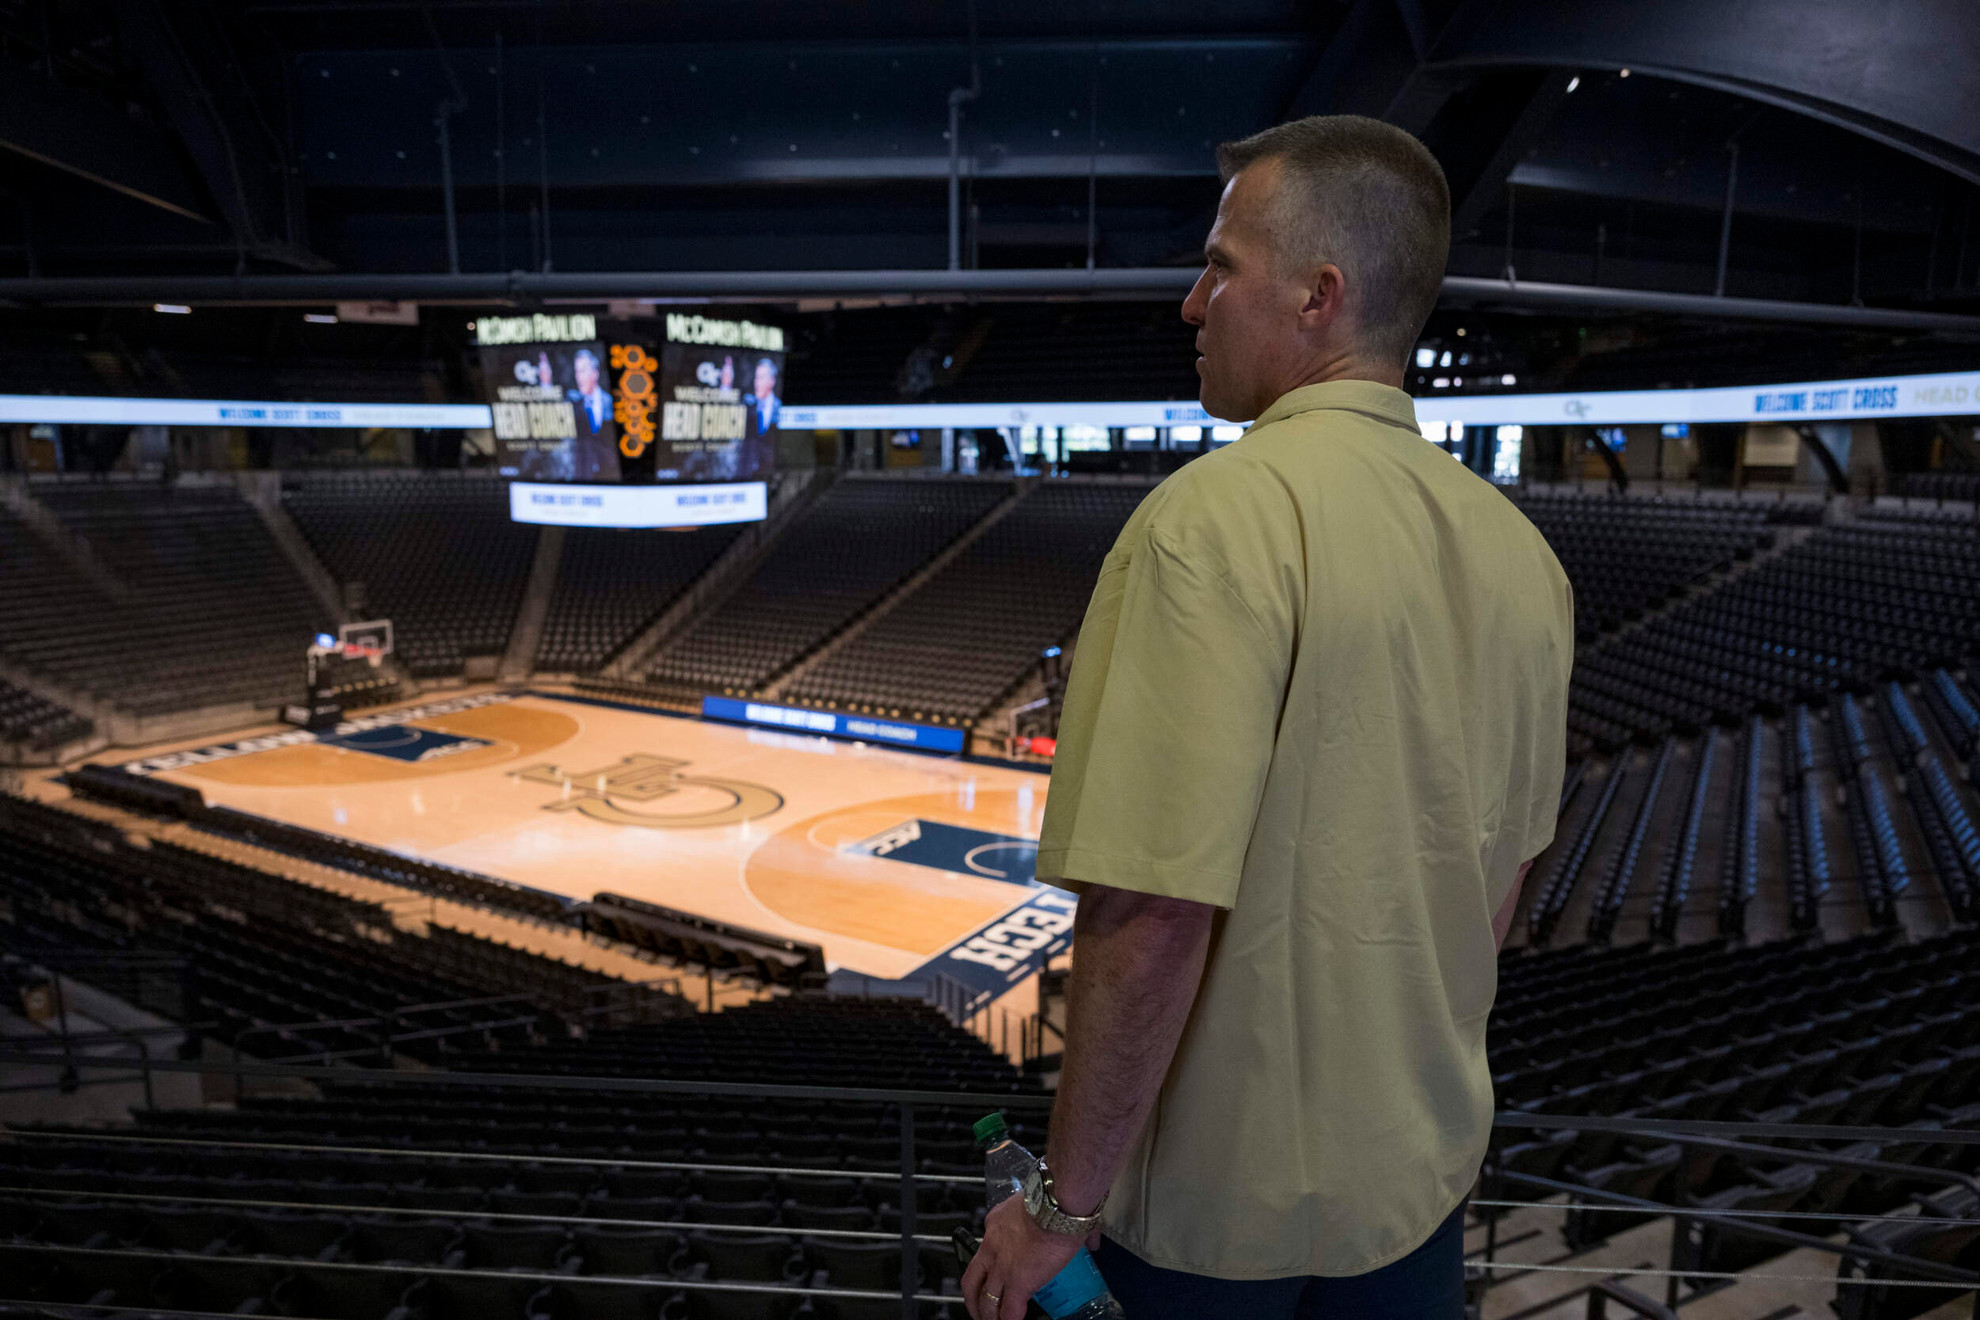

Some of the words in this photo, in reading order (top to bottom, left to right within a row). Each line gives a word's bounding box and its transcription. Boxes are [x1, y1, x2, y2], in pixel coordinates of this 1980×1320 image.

[1756, 392, 1807, 413] WELCOME
[1812, 389, 1849, 410] SCOTT
[1853, 386, 1897, 410] CROSS
[1914, 386, 1968, 406] HEAD
